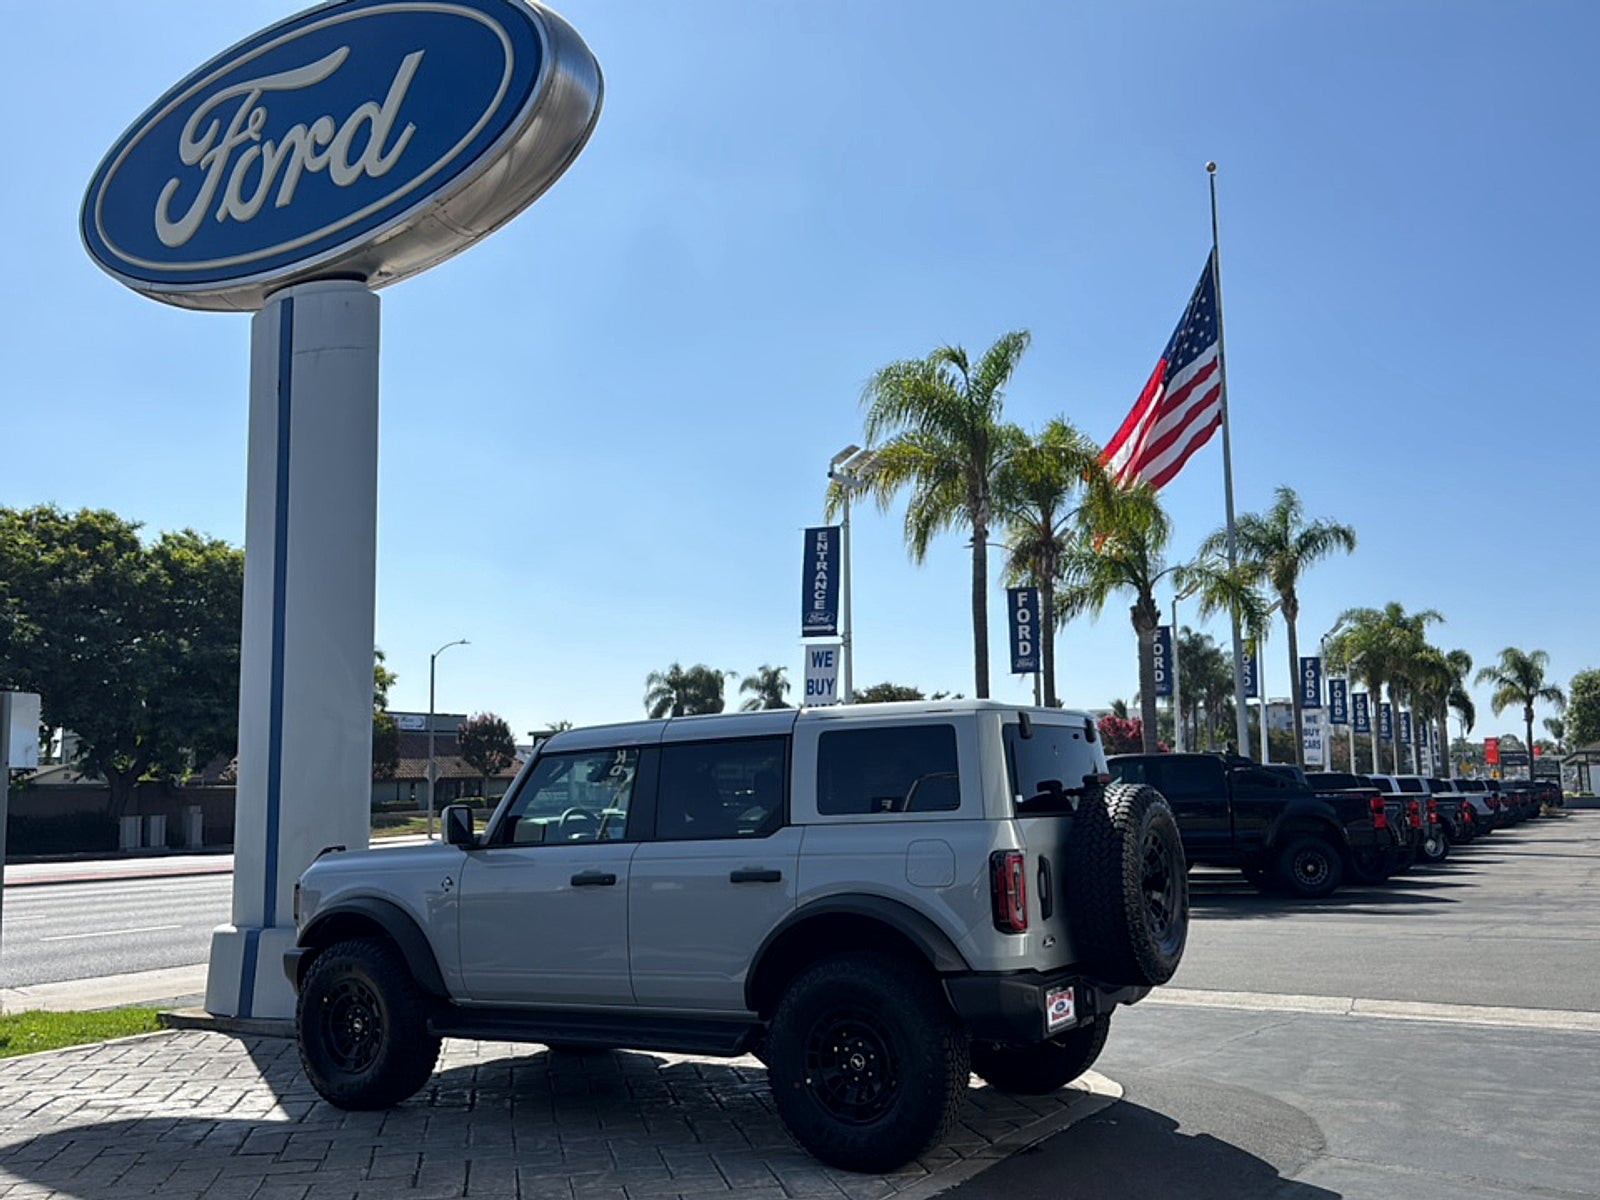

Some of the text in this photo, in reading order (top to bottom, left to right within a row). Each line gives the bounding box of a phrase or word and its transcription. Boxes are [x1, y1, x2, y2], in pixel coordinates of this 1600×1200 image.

[155, 46, 425, 248] Ford
[814, 531, 828, 610] ENTRANCE
[1017, 592, 1031, 656] FORD
[812, 650, 833, 668] WE
[806, 678, 835, 696] BUY
[1305, 660, 1315, 699] FORD
[1333, 681, 1343, 715] FORD
[1304, 740, 1321, 749] CARS
